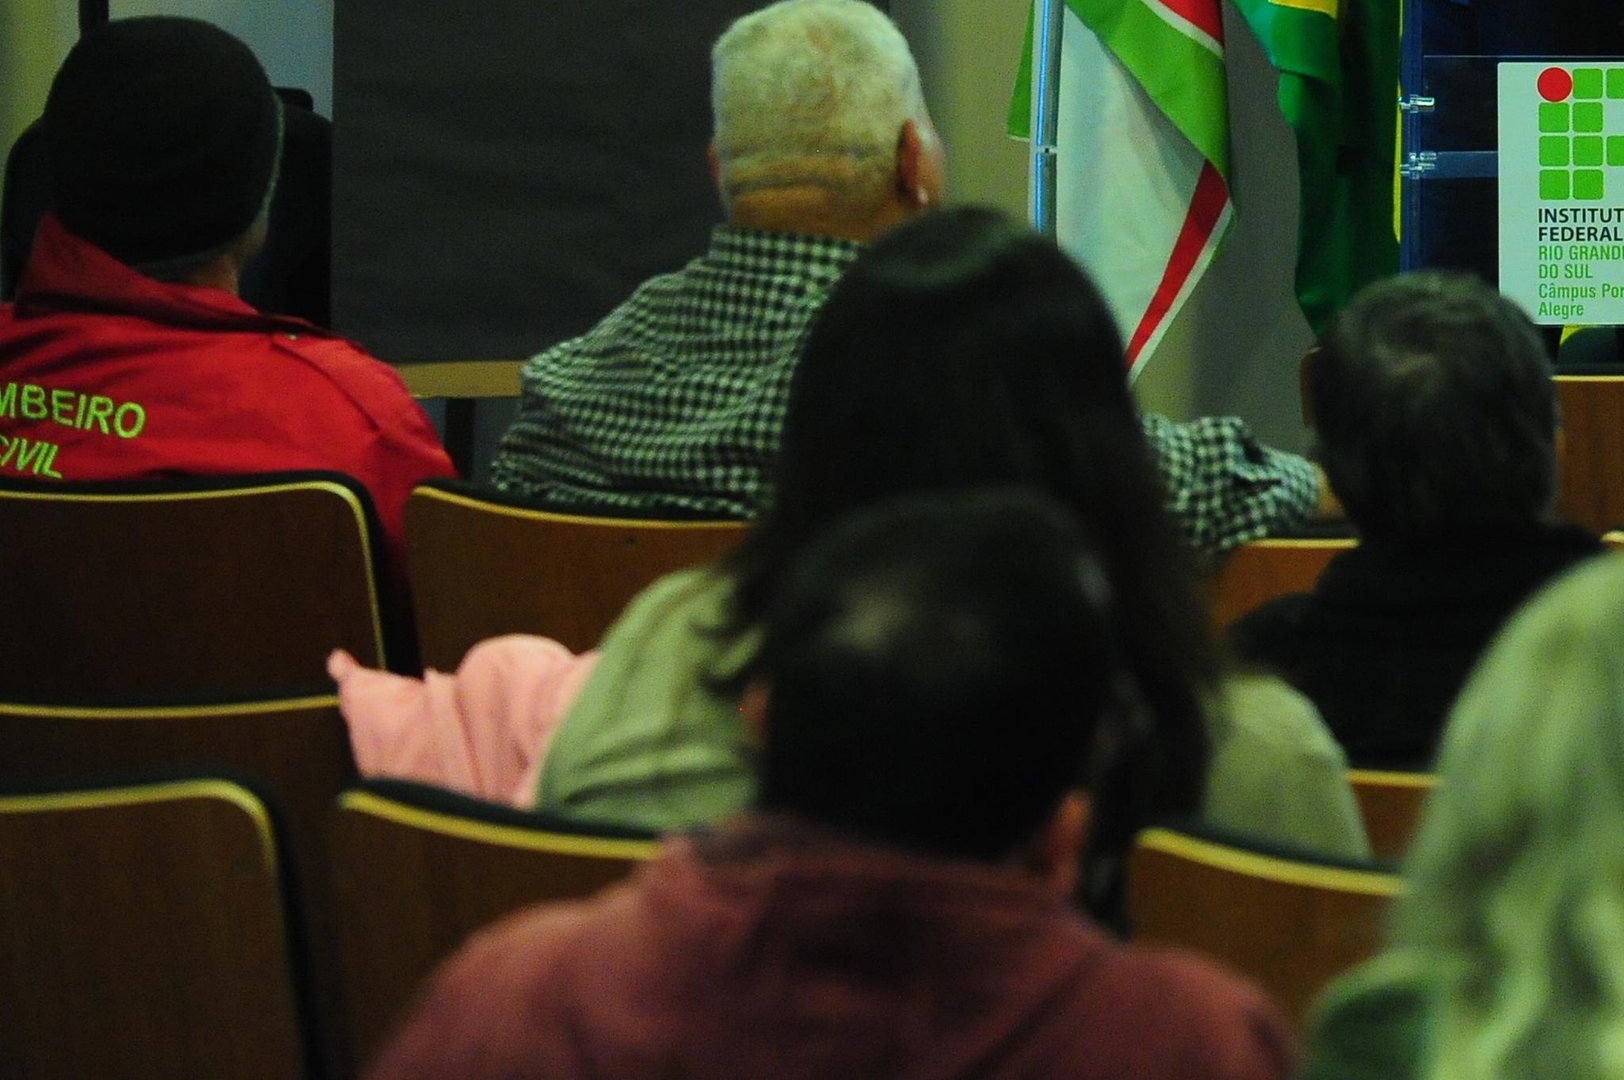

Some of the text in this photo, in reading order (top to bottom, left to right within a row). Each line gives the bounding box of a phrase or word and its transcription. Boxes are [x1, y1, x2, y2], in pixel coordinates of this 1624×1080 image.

[1538, 226, 1623, 242] FEDERAL
[1538, 245, 1563, 261] RIO
[1538, 264, 1593, 279] DO SUL
[1538, 282, 1596, 302] Câmpus
[1538, 302, 1584, 320] Alegre
